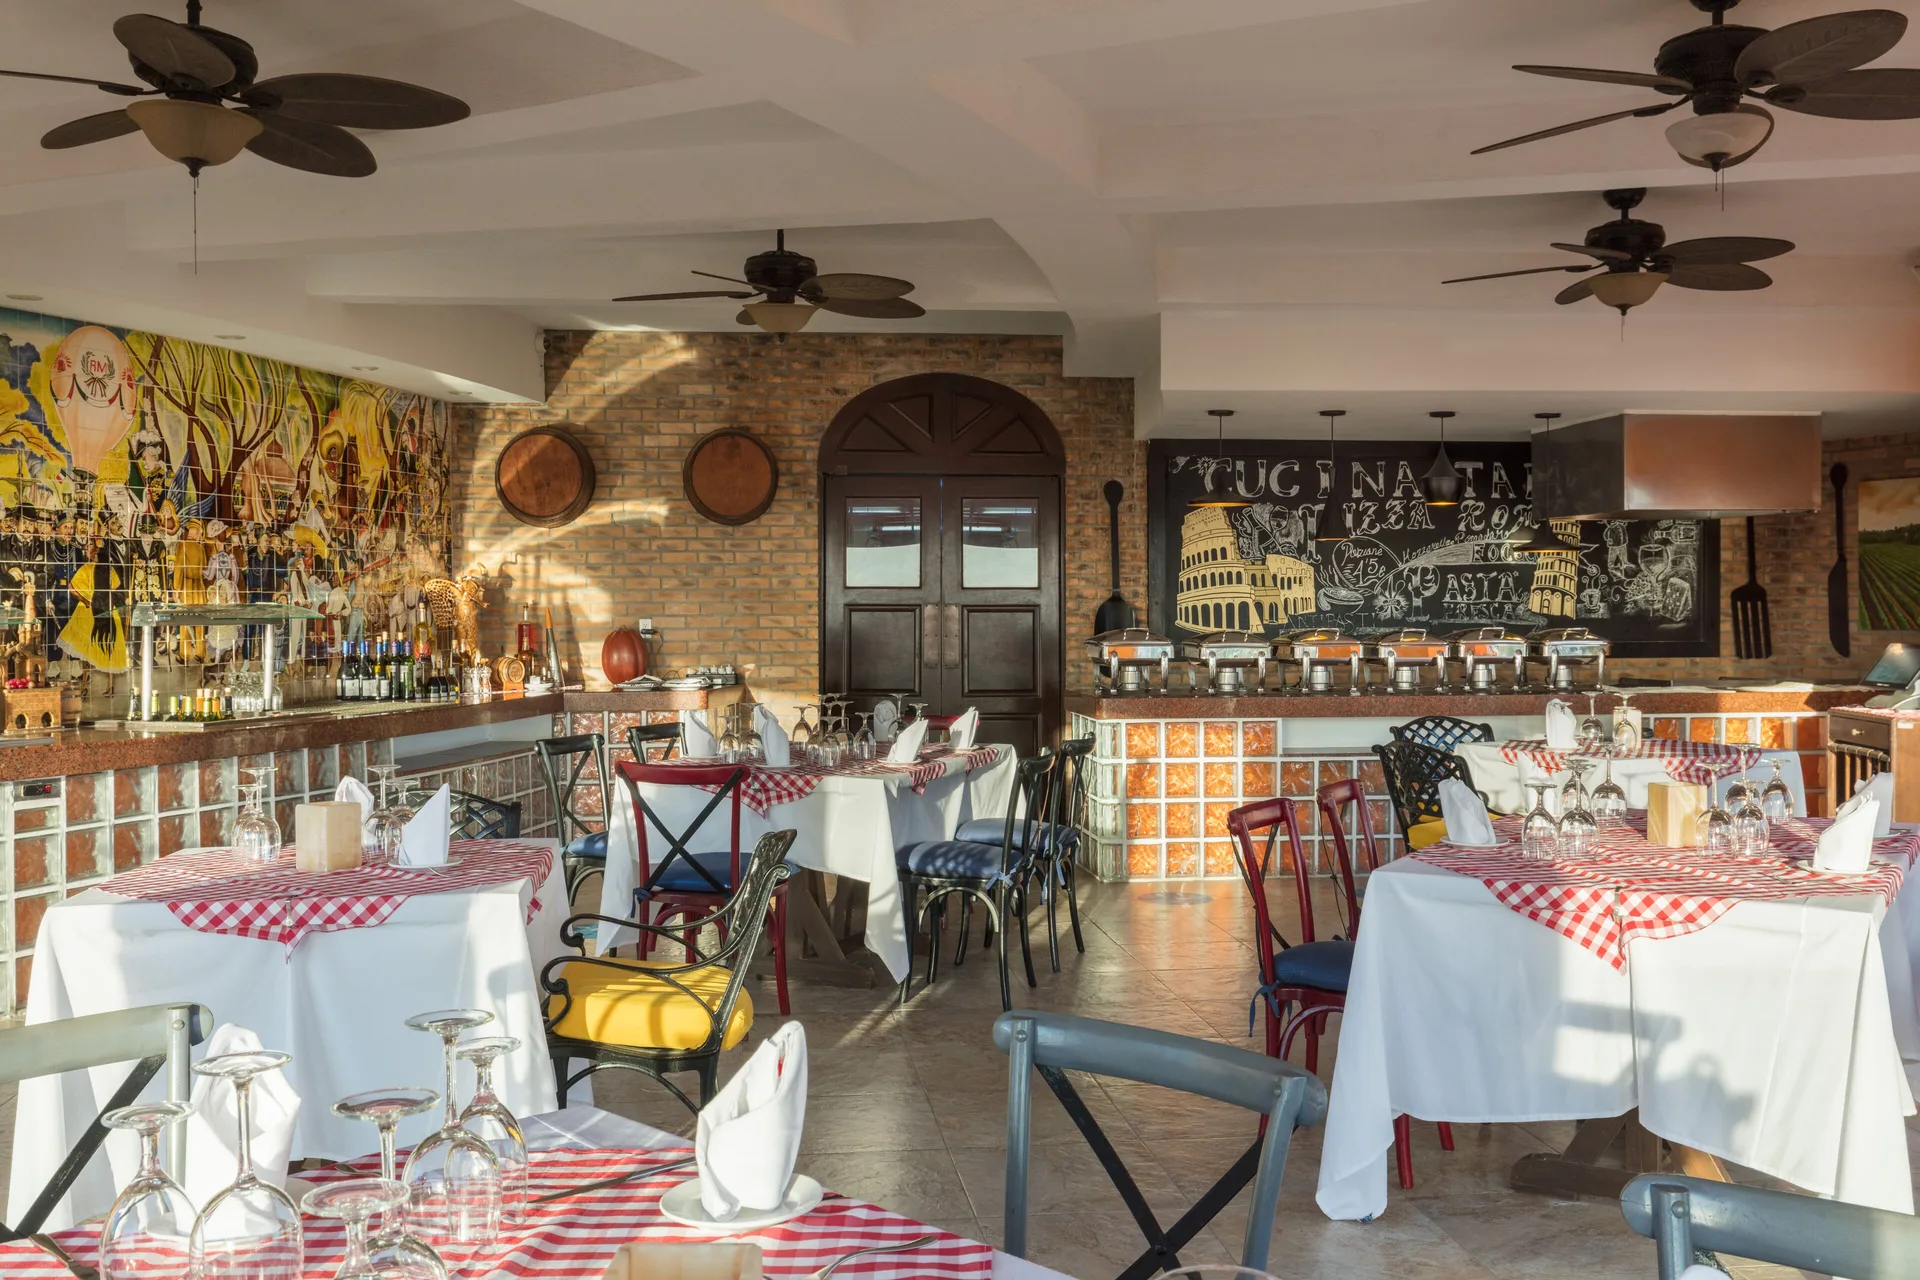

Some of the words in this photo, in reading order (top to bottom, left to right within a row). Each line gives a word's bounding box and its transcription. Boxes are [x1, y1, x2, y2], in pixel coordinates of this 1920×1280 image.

[90, 359, 108, 373] RM
[1204, 458, 1423, 498] CUCINA
[1403, 564, 1517, 622] PASTA
[1443, 603, 1515, 621] FRESCA
